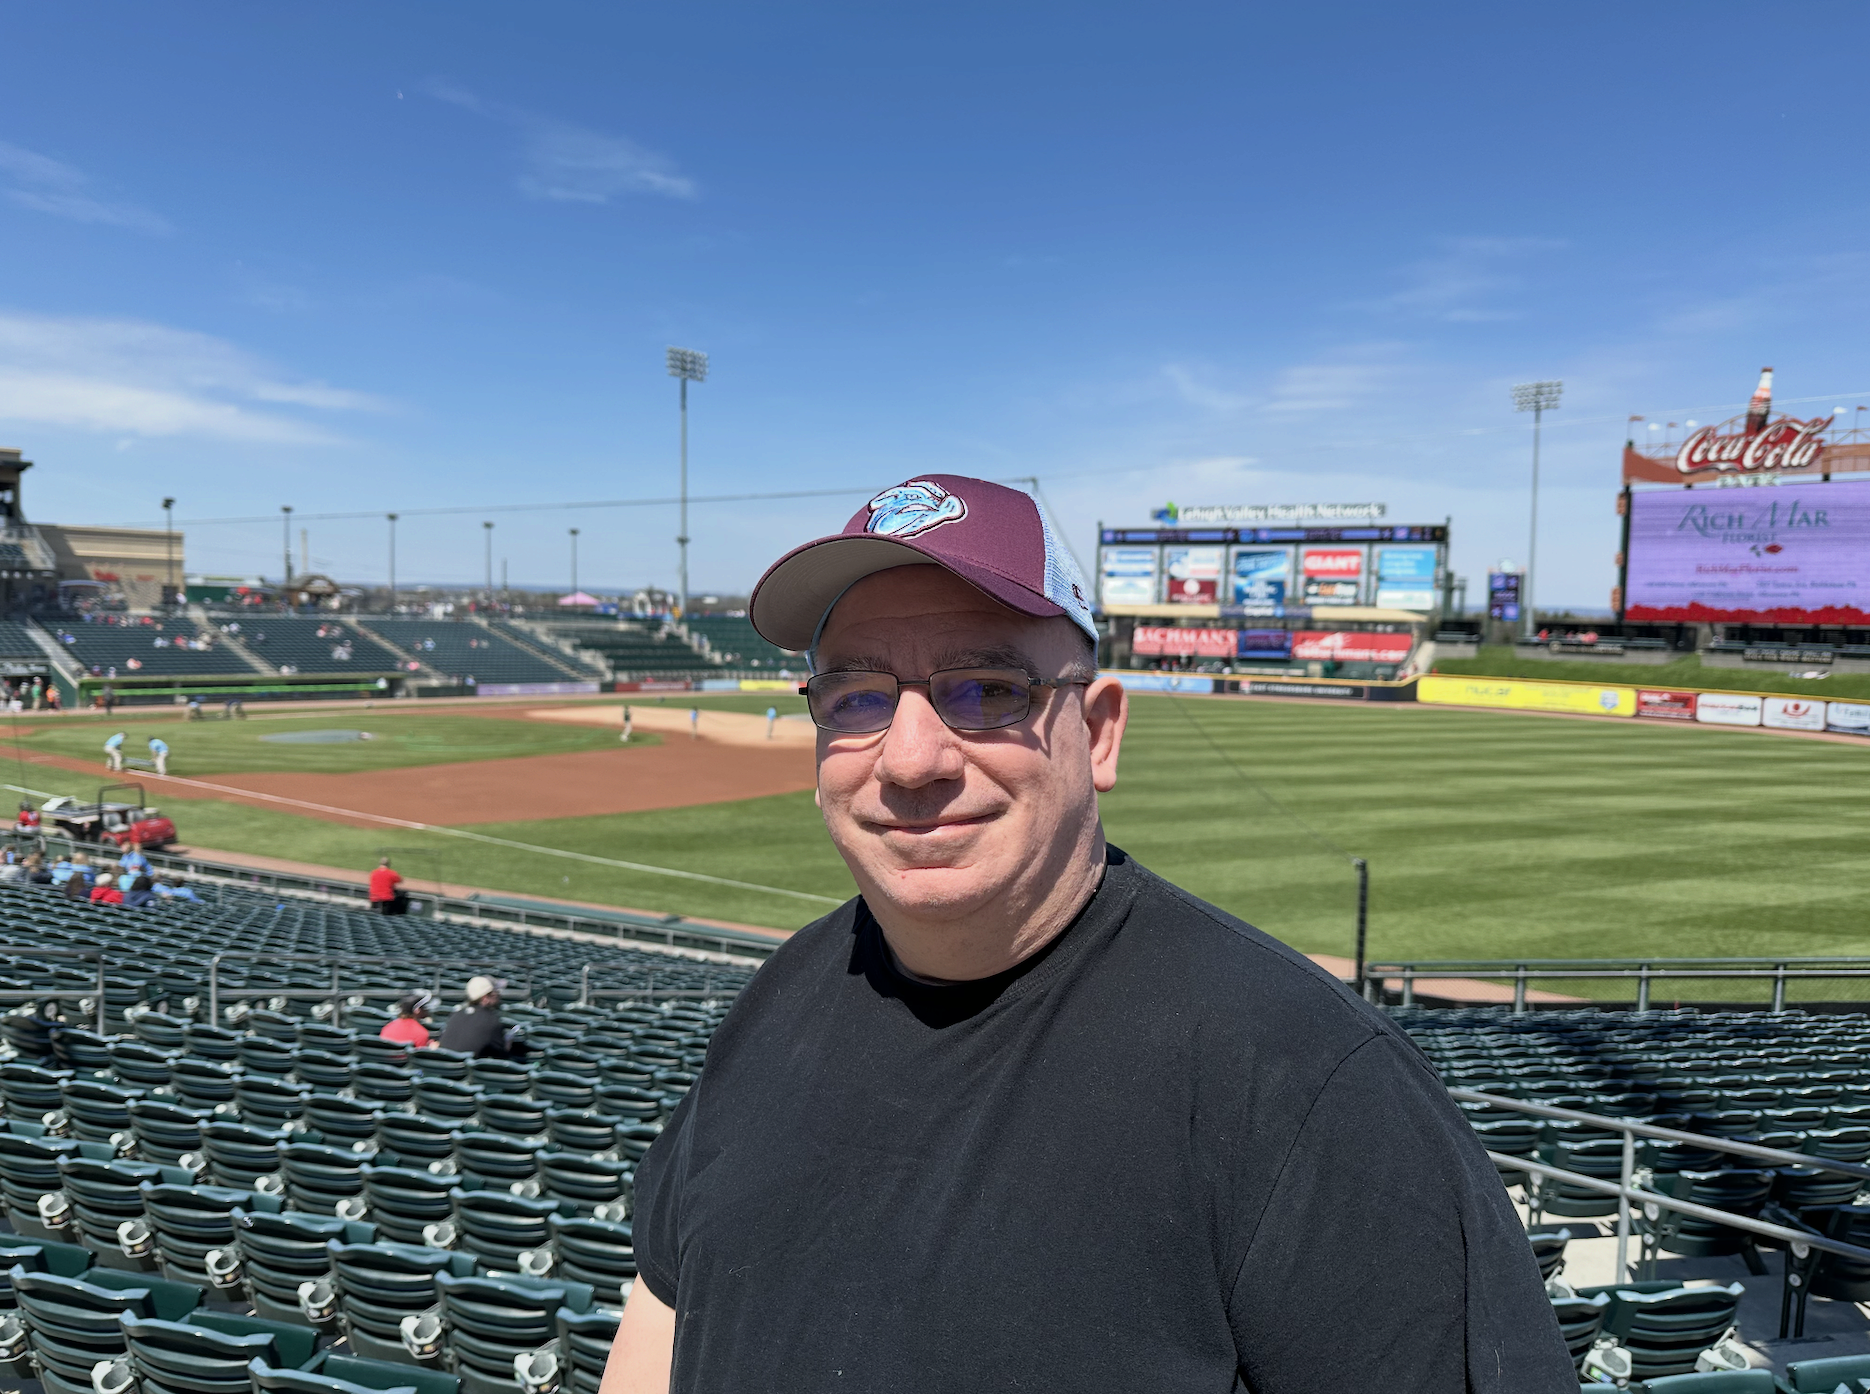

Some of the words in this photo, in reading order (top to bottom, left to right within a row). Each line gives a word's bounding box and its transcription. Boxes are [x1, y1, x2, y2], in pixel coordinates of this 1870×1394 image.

[1717, 473, 1780, 487] PARK
[1178, 506, 1223, 521] Lehigh
[1225, 505, 1264, 521] Valley
[1267, 504, 1315, 518] Health
[1317, 502, 1380, 517] Network
[1304, 555, 1360, 570] GIANT
